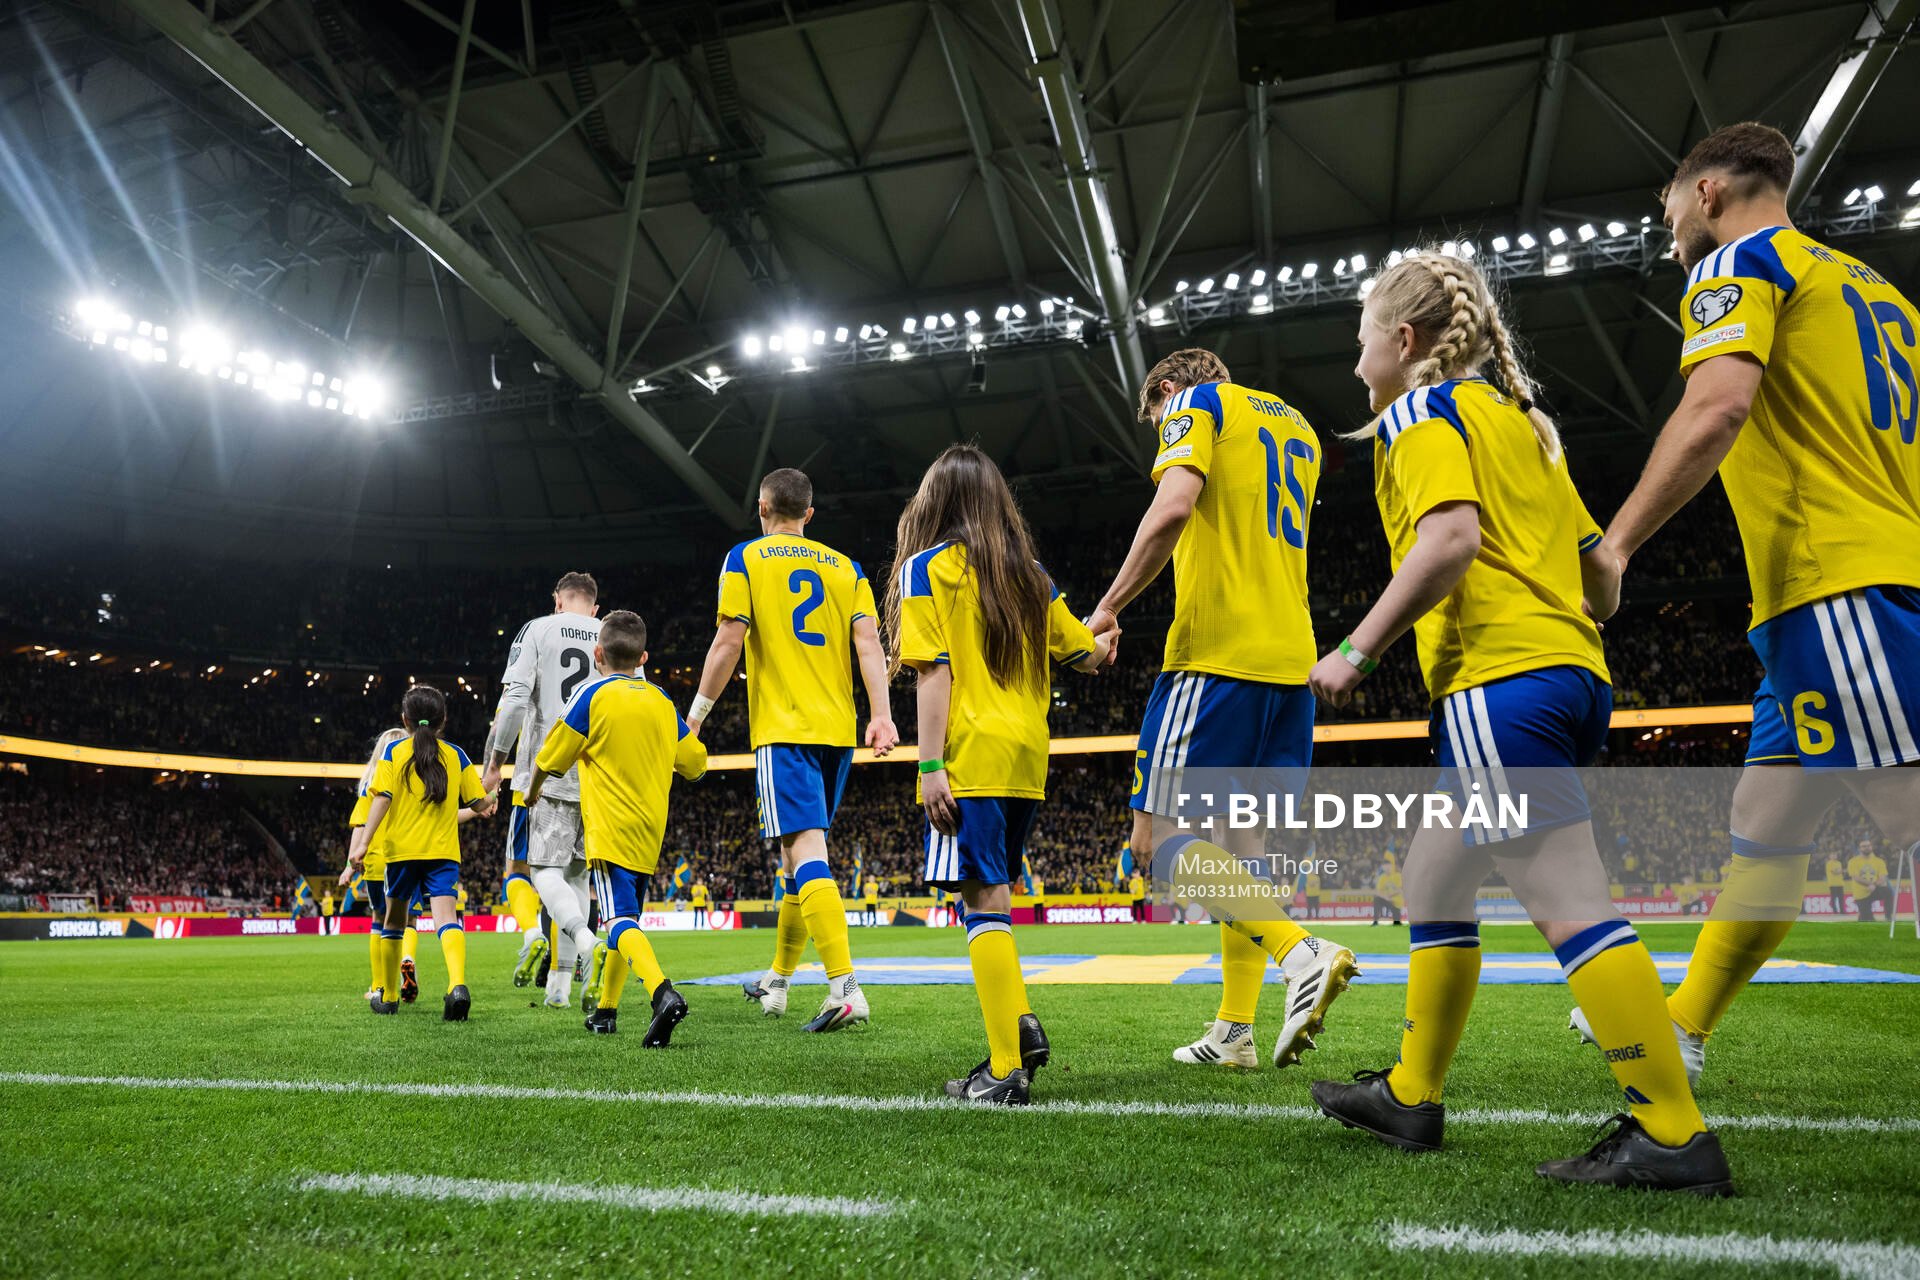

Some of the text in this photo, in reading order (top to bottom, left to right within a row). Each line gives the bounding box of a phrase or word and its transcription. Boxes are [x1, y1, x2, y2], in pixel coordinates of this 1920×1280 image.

[1258, 426, 1314, 549] 15
[788, 568, 826, 646] 2
[49, 920, 123, 937] SVENSKA SPEL
[1046, 907, 1134, 924] SVENSKA SPEL
